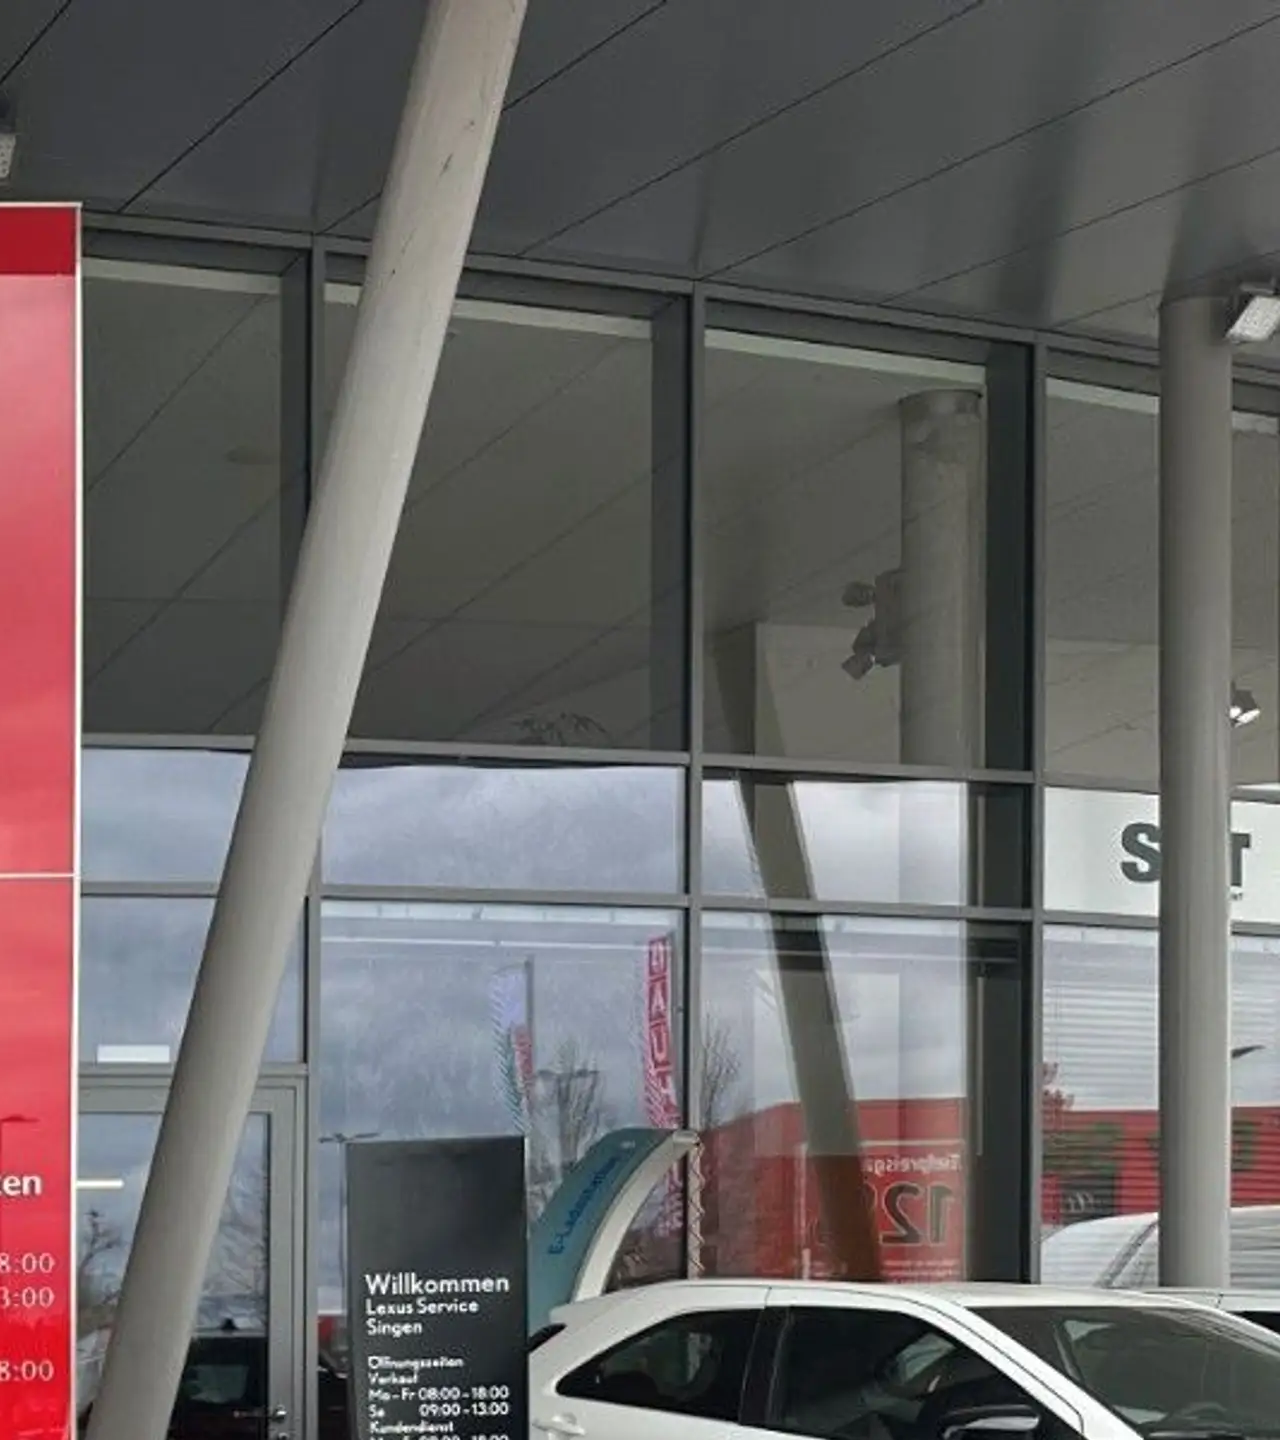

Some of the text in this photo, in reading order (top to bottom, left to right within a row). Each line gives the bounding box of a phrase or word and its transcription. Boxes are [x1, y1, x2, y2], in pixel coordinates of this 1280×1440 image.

[364, 1271, 510, 1295] Willkommen
[366, 1297, 479, 1315] Lexus Service
[366, 1317, 422, 1337] Singen
